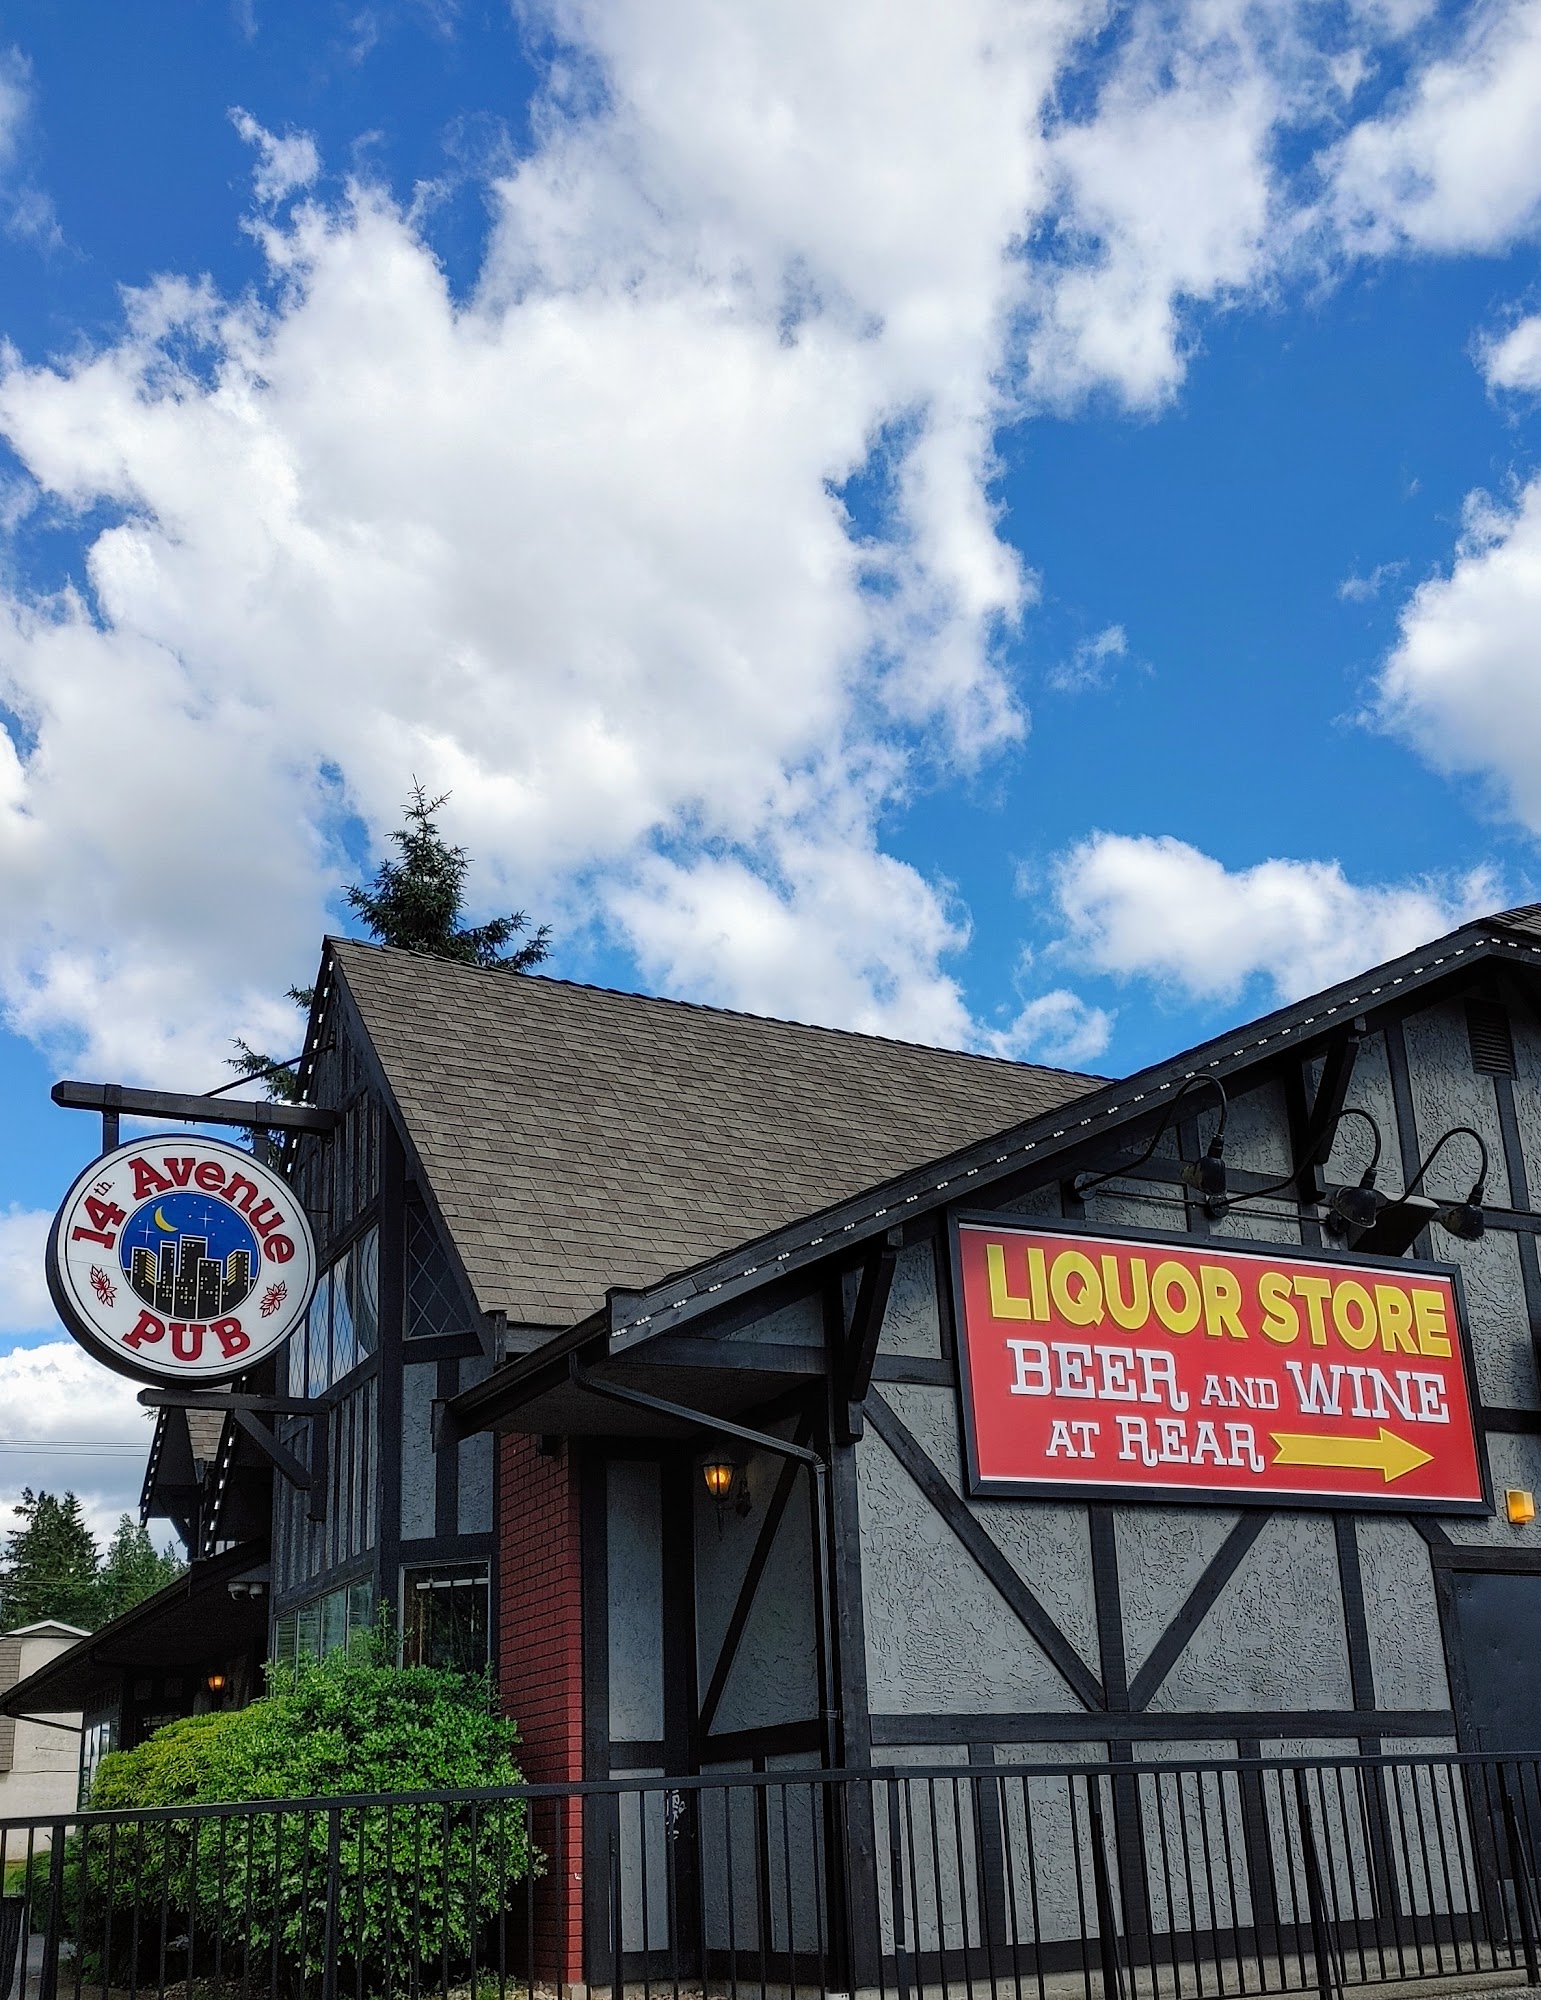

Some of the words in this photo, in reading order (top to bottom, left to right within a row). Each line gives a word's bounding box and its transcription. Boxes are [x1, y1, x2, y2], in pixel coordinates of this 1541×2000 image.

[128, 1157, 295, 1264] Avenue
[121, 1309, 251, 1361] PUB
[986, 1244, 1249, 1339] LIQUOR
[1258, 1272, 1453, 1358] STORE
[1006, 1339, 1190, 1412] BEER
[1200, 1374, 1279, 1410] AND
[1285, 1361, 1450, 1424] WINE
[1045, 1420, 1100, 1459] AT
[1115, 1416, 1266, 1473] REAR
